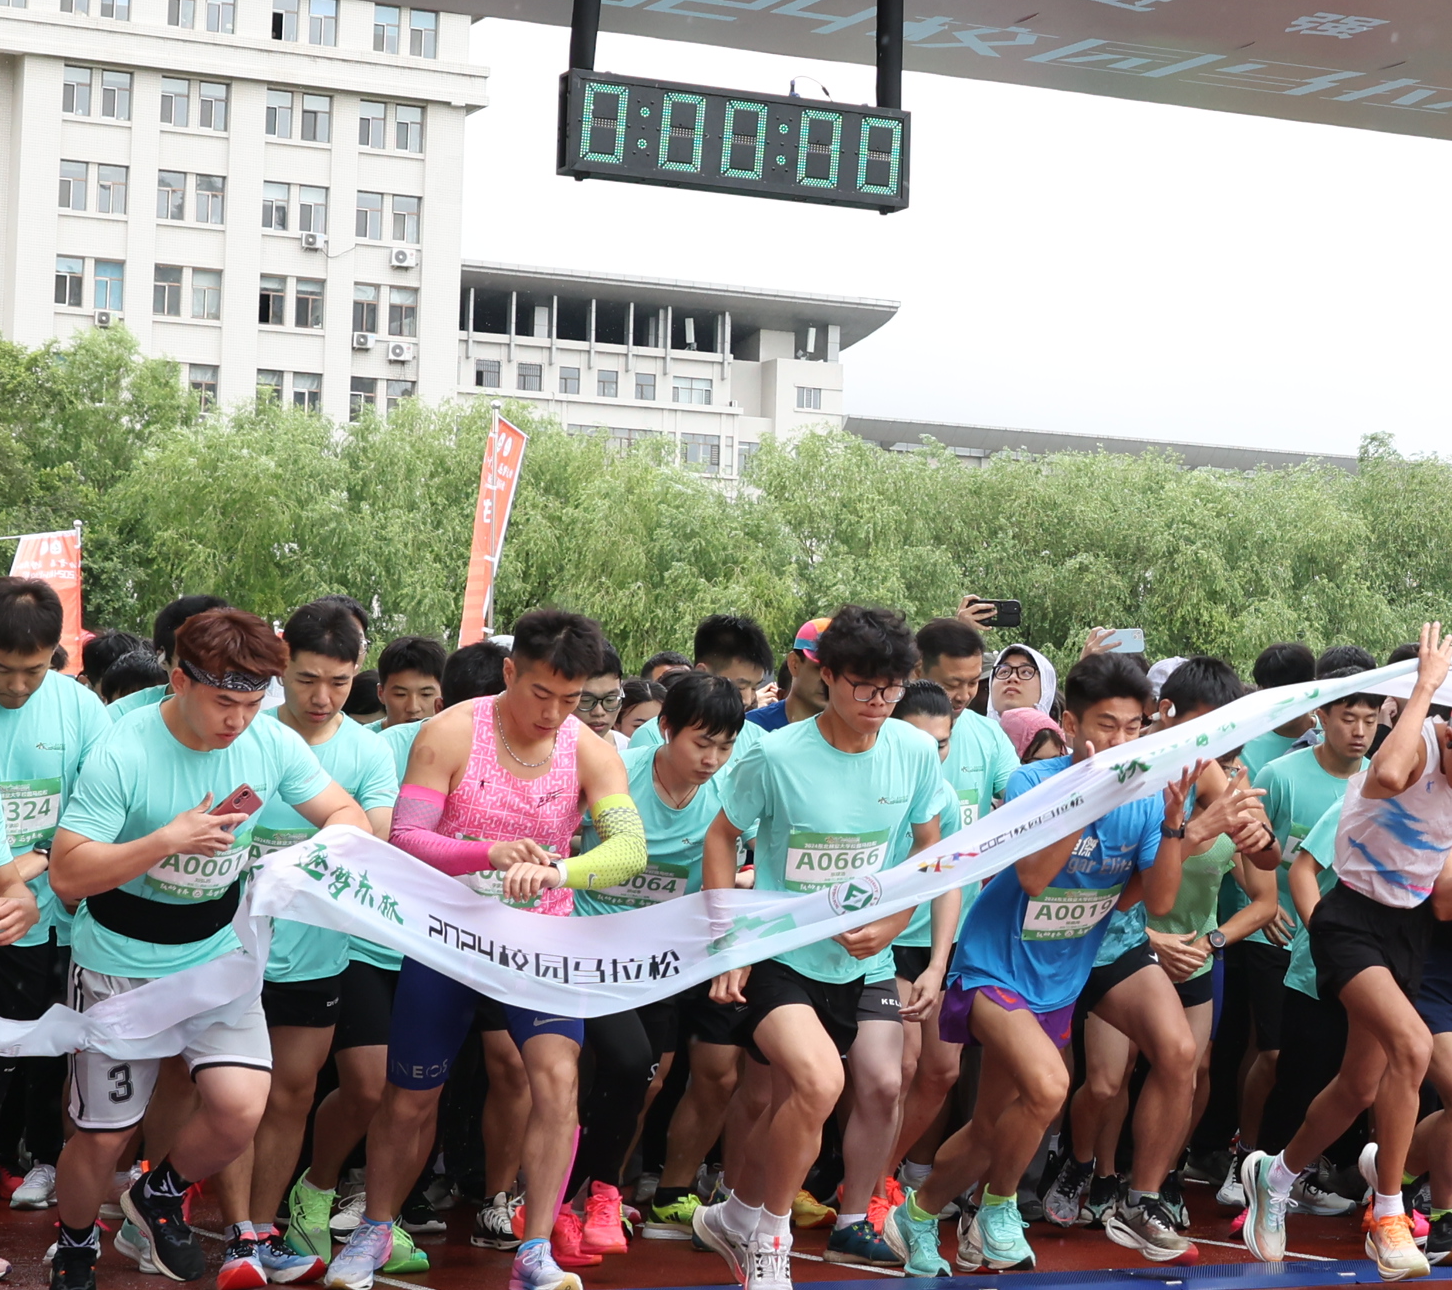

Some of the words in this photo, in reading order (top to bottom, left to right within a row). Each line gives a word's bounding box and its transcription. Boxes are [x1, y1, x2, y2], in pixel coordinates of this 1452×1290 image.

[579, 81, 903, 197] 0:00:00
[3, 798, 51, 822] 324
[159, 853, 243, 877] A0001
[795, 848, 880, 871] A0666
[1034, 899, 1113, 921] A0019
[107, 1062, 135, 1105] 3
